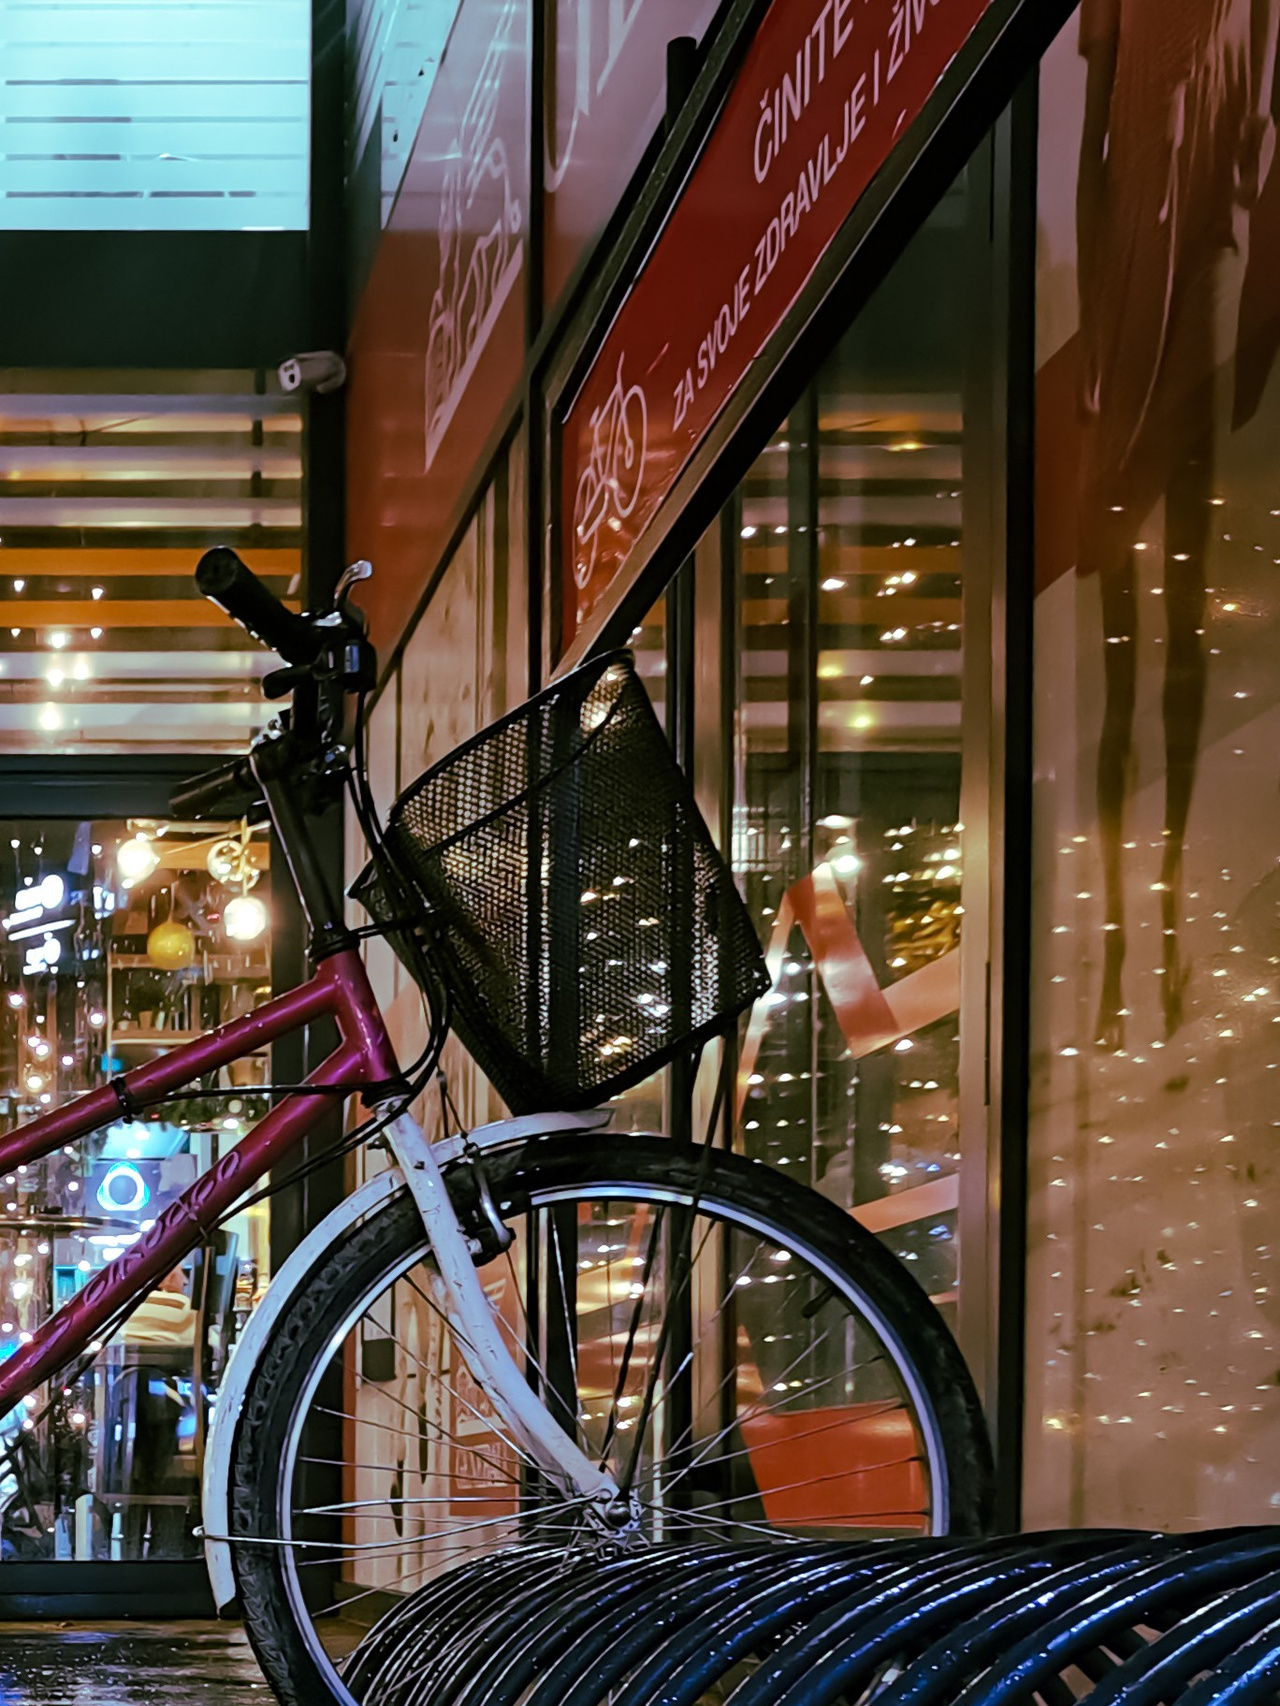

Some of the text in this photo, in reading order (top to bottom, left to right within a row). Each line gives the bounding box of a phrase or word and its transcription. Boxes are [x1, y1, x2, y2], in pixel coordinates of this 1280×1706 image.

[672, 0, 939, 433] ZA SVOJE ZDRAVLJE I ŽIV
[754, 0, 854, 184] ČINITE
